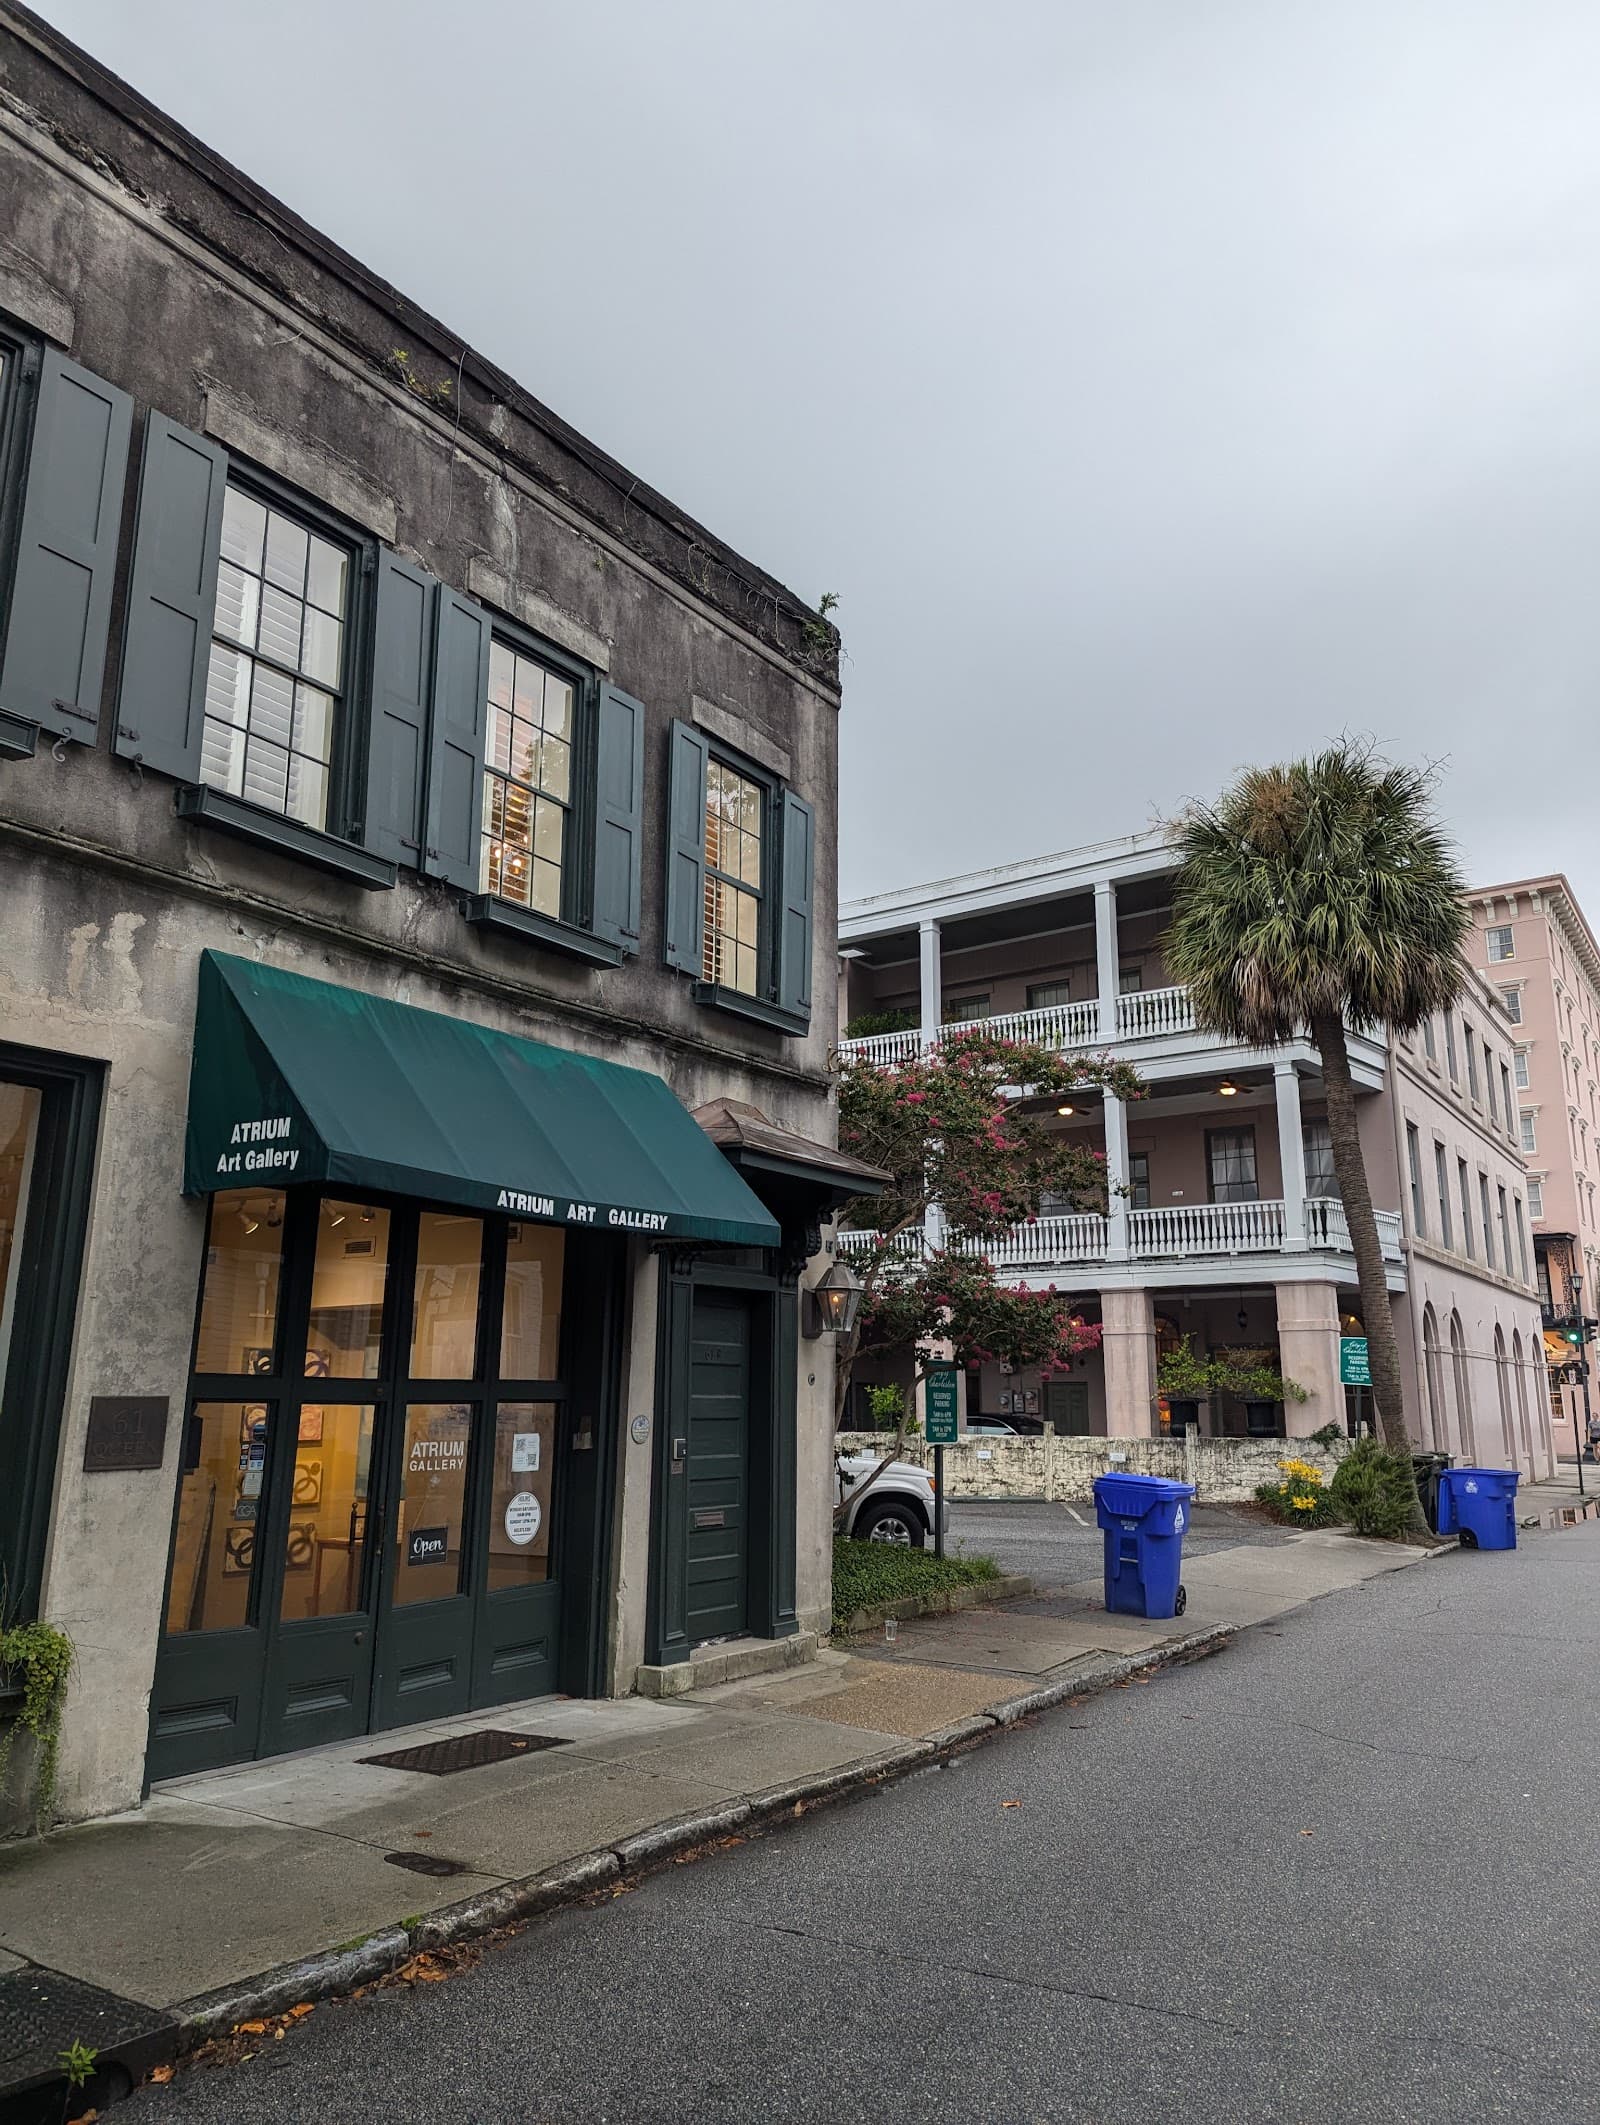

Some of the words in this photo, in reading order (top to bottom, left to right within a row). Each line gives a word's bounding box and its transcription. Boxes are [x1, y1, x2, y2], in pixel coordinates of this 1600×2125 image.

[231, 1117, 291, 1144] ATRIUM
[217, 1153, 241, 1172] Art
[245, 1148, 299, 1170] Gallery
[497, 1190, 554, 1216] ATRIUM
[567, 1203, 596, 1223] ART
[608, 1209, 668, 1231] GALLERY
[112, 1408, 145, 1436] 61
[92, 1441, 158, 1463] QUEEN
[410, 1441, 465, 1458] ATRIUM
[409, 1458, 465, 1472] GALLERY
[413, 1537, 444, 1561] Open
